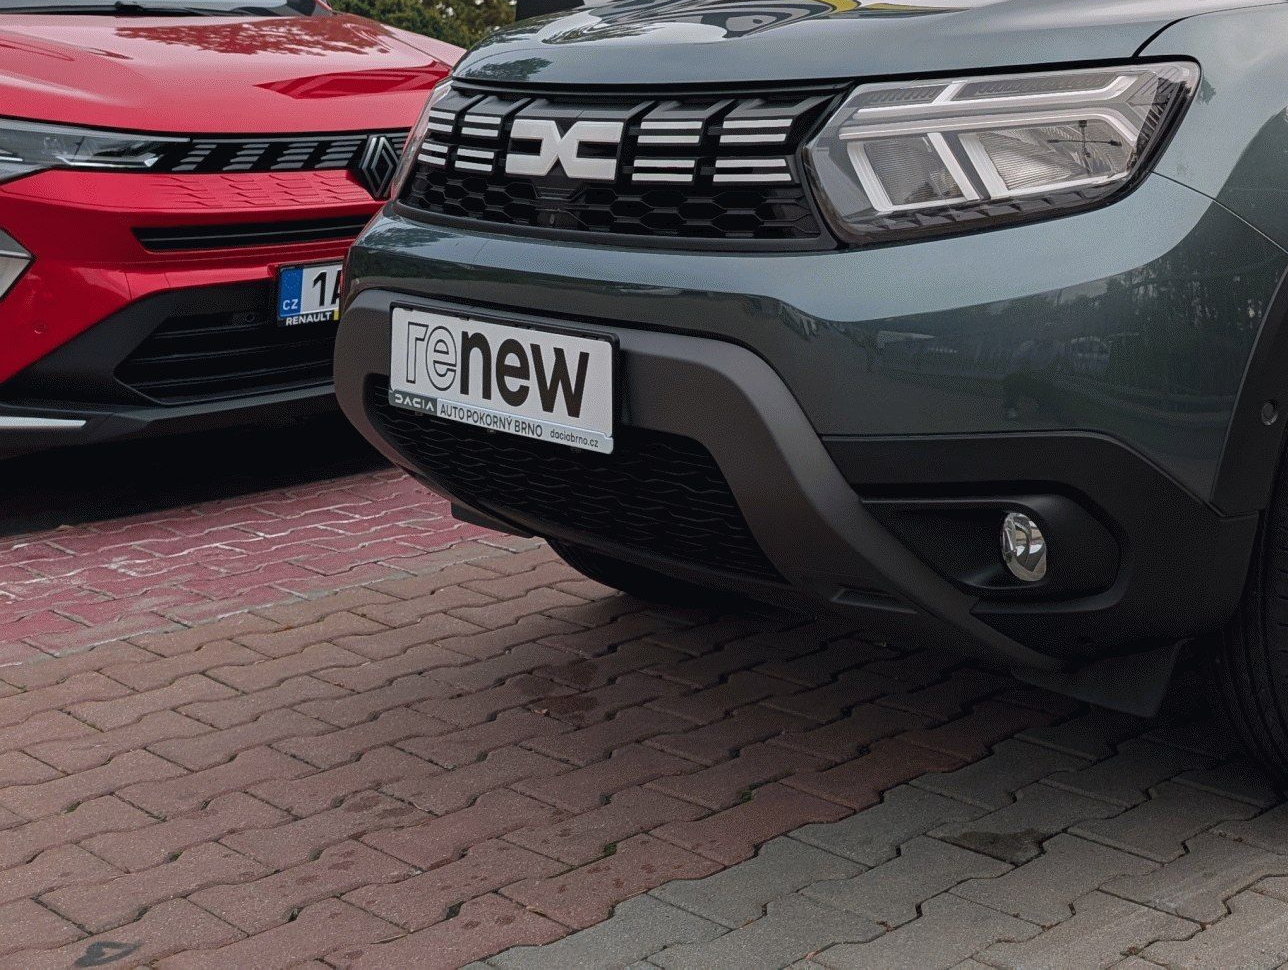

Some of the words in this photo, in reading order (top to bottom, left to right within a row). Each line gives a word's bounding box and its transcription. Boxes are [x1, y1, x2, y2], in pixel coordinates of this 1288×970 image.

[282, 299, 298, 311] CZ
[285, 312, 332, 326] RENAULT
[405, 321, 590, 418] renew
[394, 393, 435, 412] DACIA
[440, 403, 465, 421] AUTO
[466, 409, 513, 431] POKORNÝ
[514, 421, 543, 438] BRNO
[550, 429, 599, 448] daciabrno.cz
